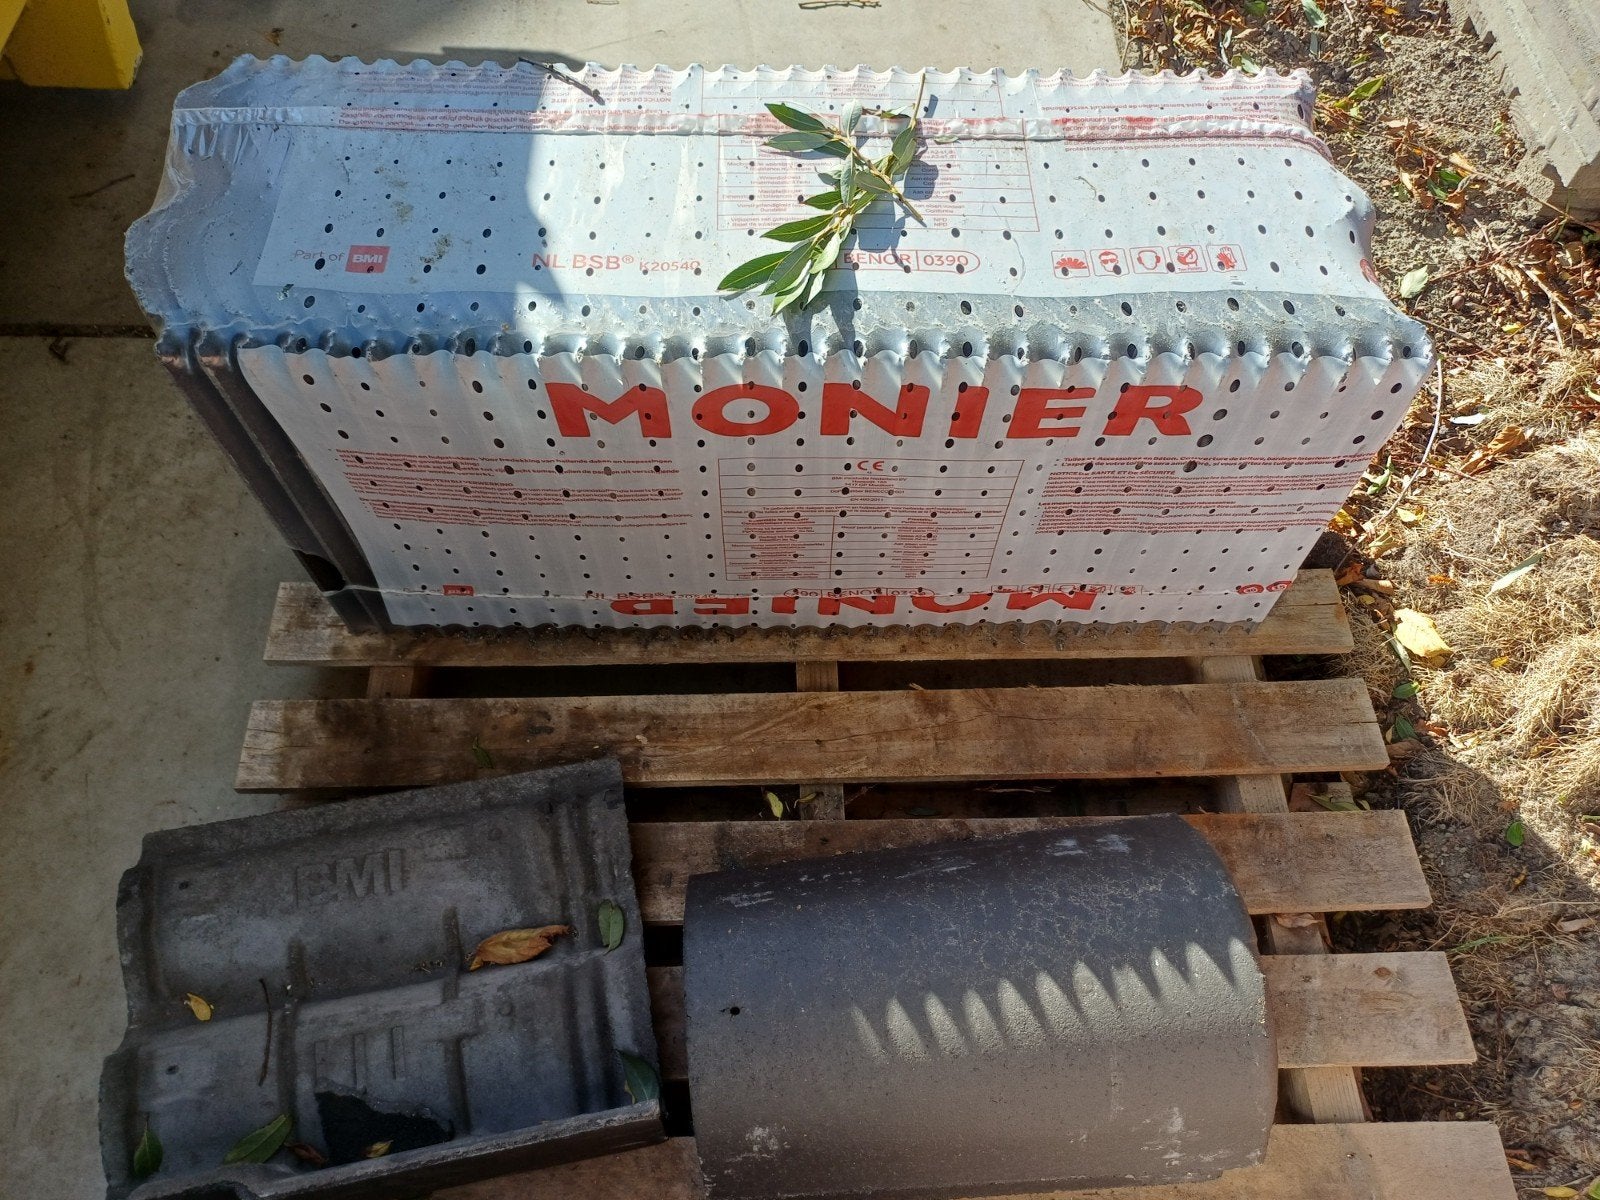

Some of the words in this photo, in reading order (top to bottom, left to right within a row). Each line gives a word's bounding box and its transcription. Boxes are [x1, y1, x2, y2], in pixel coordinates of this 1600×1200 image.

[294, 249, 325, 260] Part
[328, 252, 345, 262] of
[352, 254, 383, 264] BMI
[532, 253, 565, 269] NL
[639, 261, 701, 272] K20540
[844, 252, 912, 265] BENOR
[924, 254, 969, 266] 0390
[545, 382, 1204, 439] MONIER
[294, 848, 407, 907] BMI
